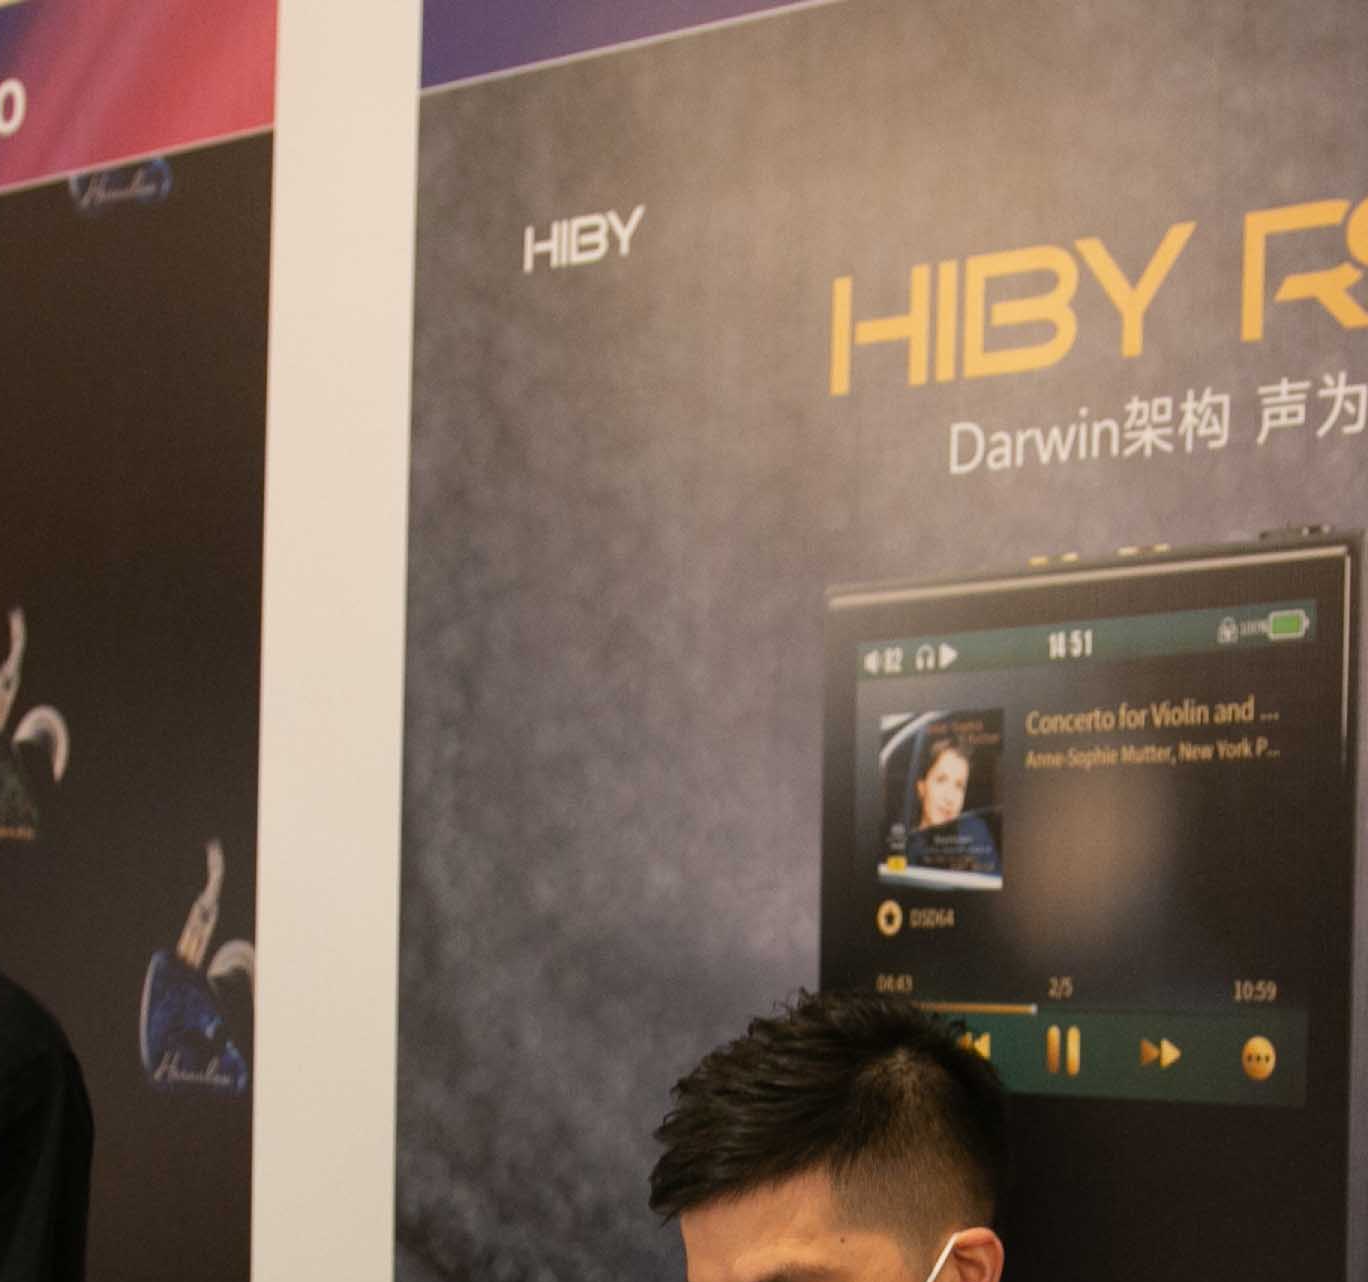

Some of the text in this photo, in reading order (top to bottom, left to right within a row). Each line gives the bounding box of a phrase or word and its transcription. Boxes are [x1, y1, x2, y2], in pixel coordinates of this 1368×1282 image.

[522, 204, 646, 274] HIBY
[831, 220, 1199, 397] HIBY
[948, 386, 1232, 475] Darwin架构
[1025, 707, 1115, 735] Concerto
[1118, 702, 1148, 730] for
[1150, 698, 1210, 728] Violin
[1213, 694, 1256, 723] and
[1178, 740, 1214, 761] New
[1216, 736, 1252, 761] York
[1048, 975, 1073, 1000] 2/5
[1233, 980, 1277, 1003] 10:59
